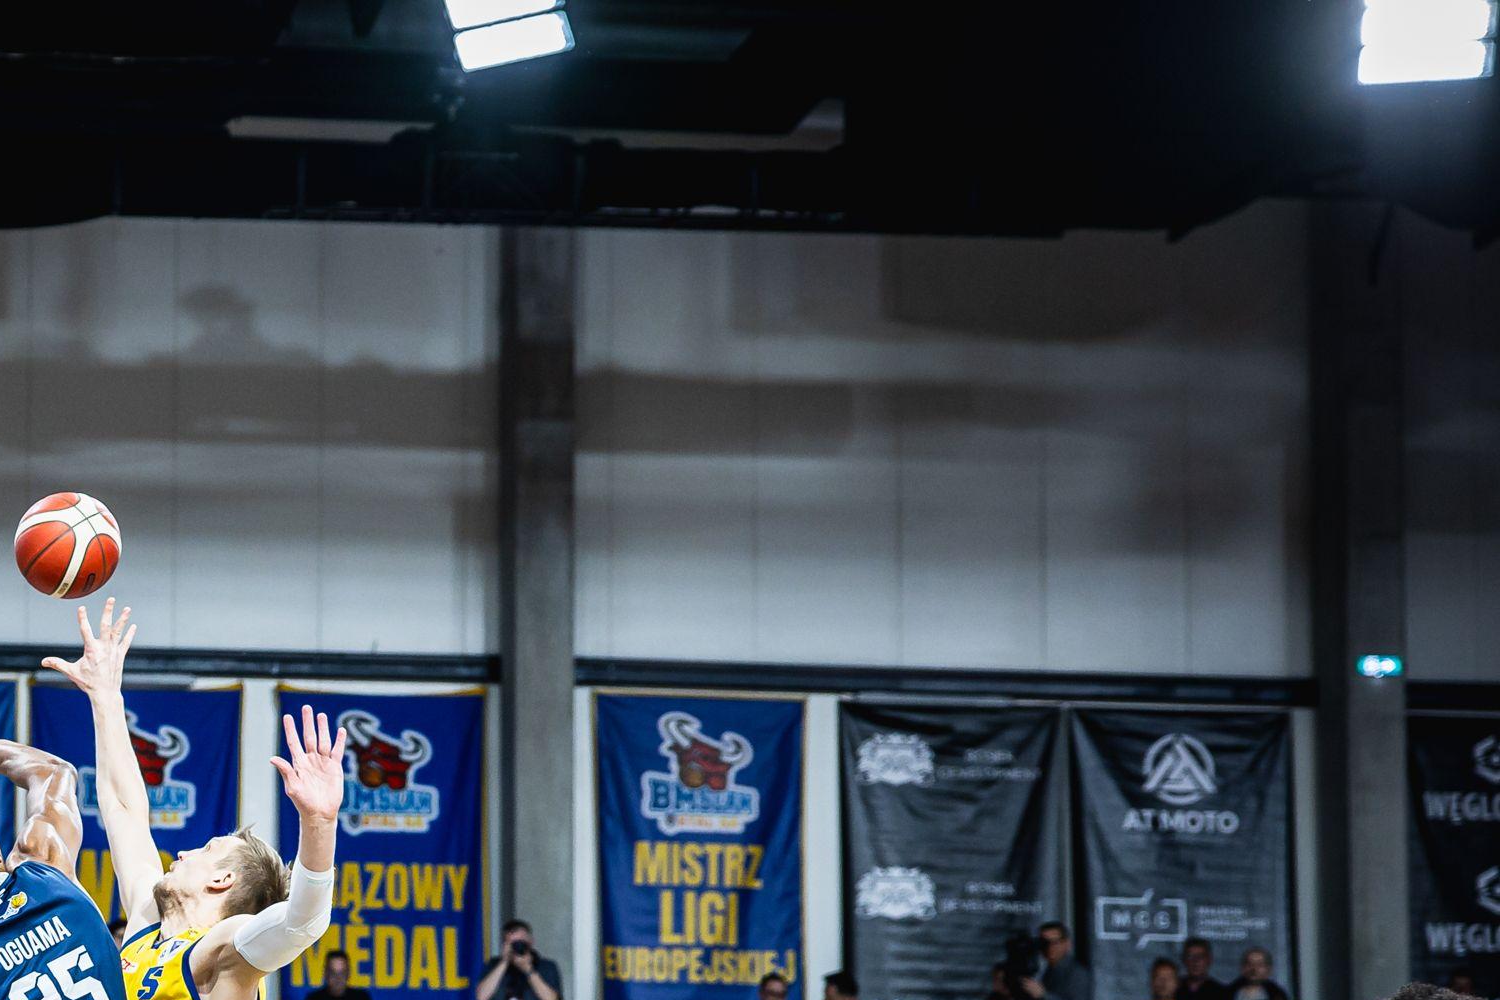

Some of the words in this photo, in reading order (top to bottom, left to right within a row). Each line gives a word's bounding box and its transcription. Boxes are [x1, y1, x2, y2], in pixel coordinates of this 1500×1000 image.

[633, 841, 764, 889] MISTRZ
[659, 891, 739, 947] LIGI
[136, 966, 165, 1000] 5
[605, 947, 797, 986] EUROPEJSKIEJ
